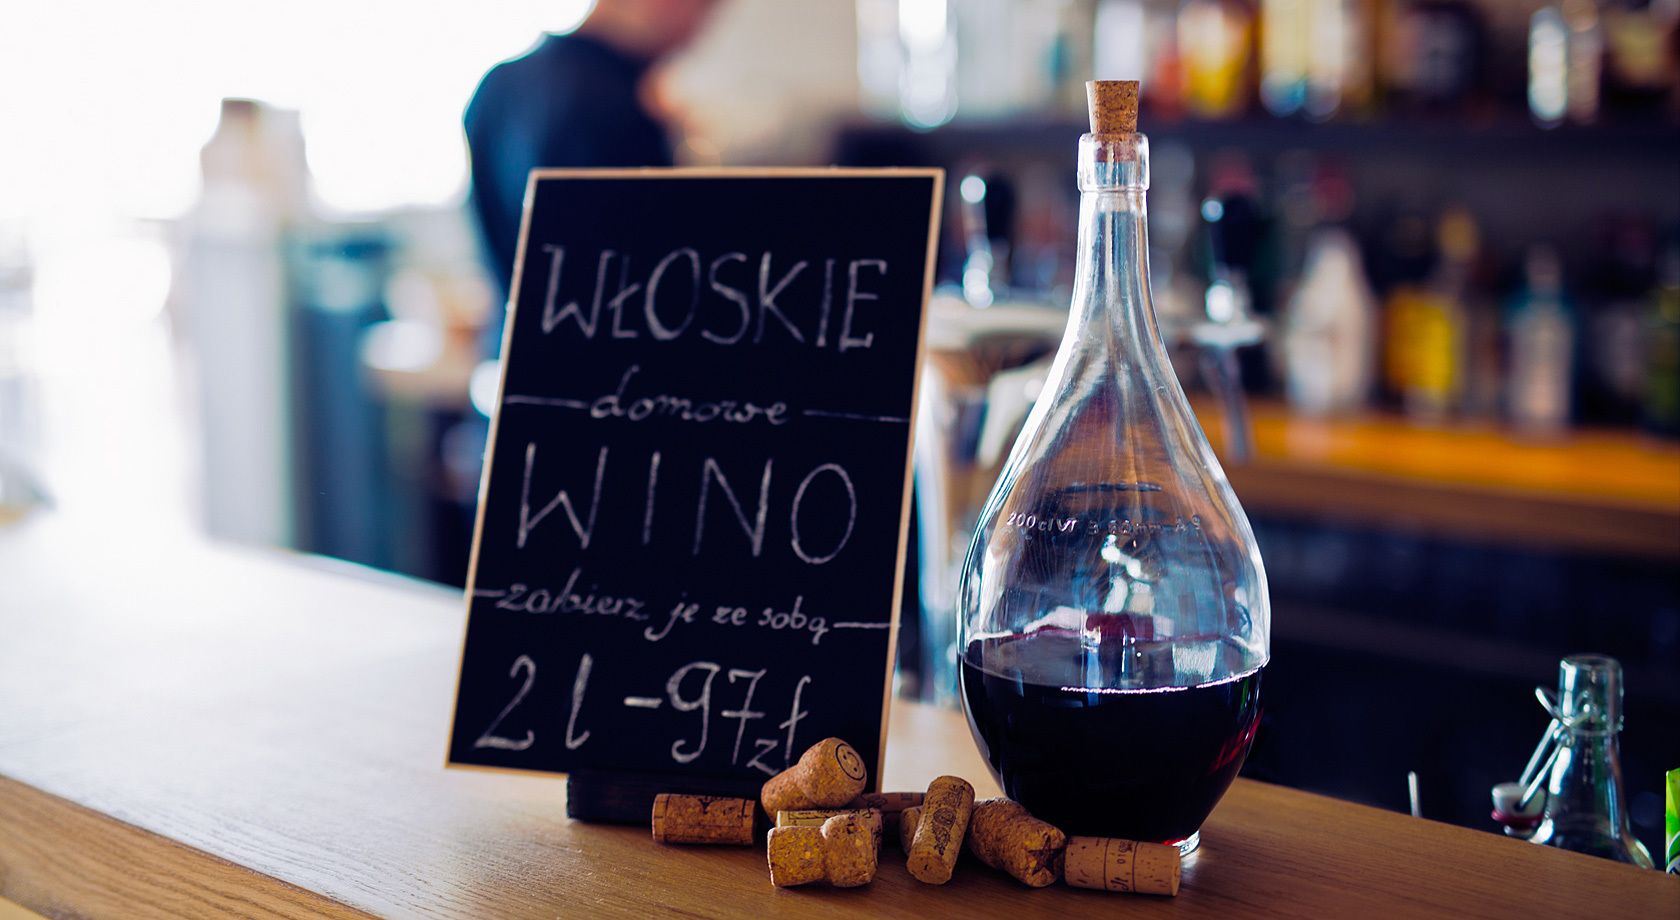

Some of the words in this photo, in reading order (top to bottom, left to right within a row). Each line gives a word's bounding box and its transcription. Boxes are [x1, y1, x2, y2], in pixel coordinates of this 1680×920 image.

[541, 244, 888, 352] WŁOSKIE
[590, 364, 790, 426] domowe
[517, 442, 857, 565] WINO
[496, 567, 649, 621] zabierz
[644, 591, 700, 642] je
[712, 606, 748, 626] ze
